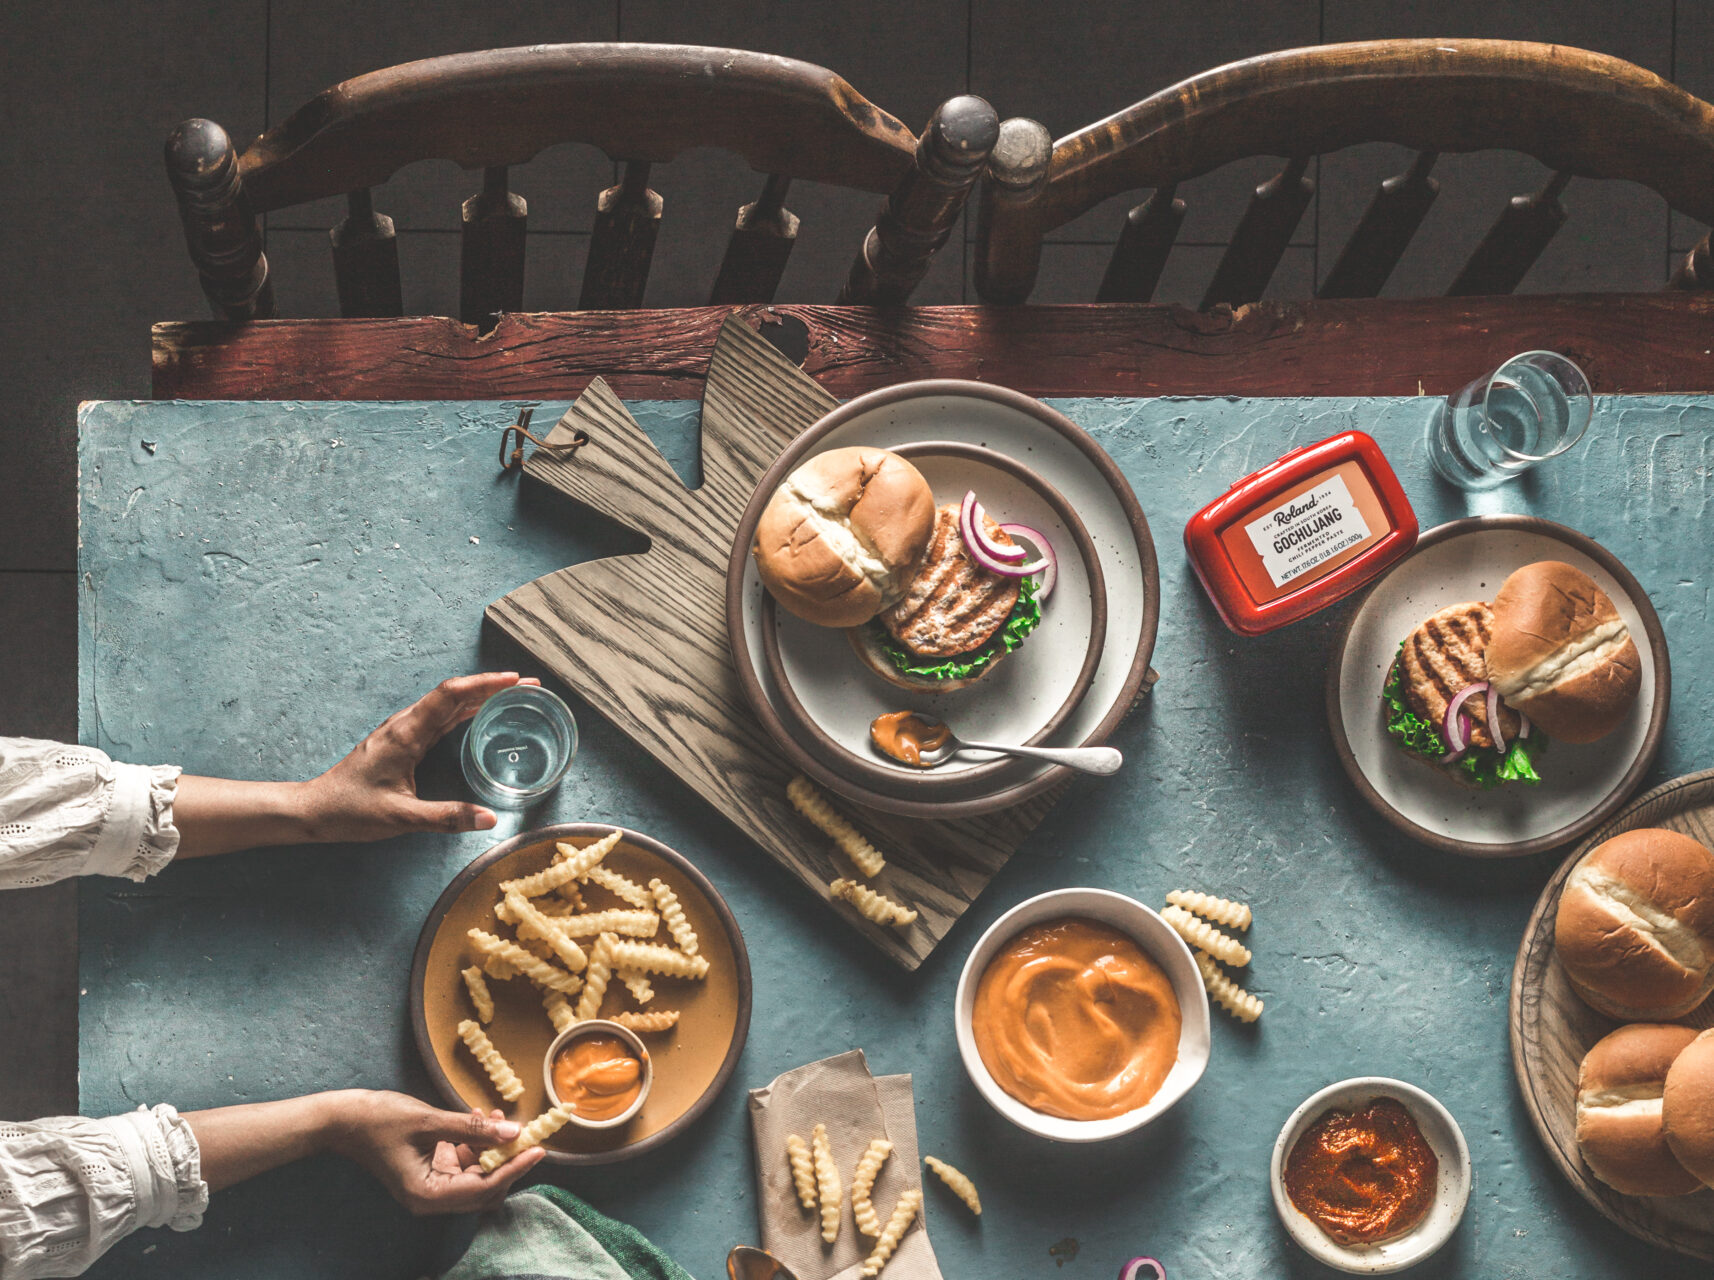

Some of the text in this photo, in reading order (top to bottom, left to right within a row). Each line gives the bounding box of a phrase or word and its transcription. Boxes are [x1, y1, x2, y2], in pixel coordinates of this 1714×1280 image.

[1273, 494, 1318, 527] Roland
[1274, 526, 1294, 539] CRAFTED
[1300, 513, 1316, 524] SOUTH
[1317, 505, 1332, 515] KOREA
[1273, 508, 1342, 554] GOCHUJANG
[1288, 530, 1343, 563] CHILI PEPPER PASTE
[1297, 532, 1330, 551] FERMENTED
[1281, 571, 1292, 580] NET
[1348, 533, 1363, 543] 500g
